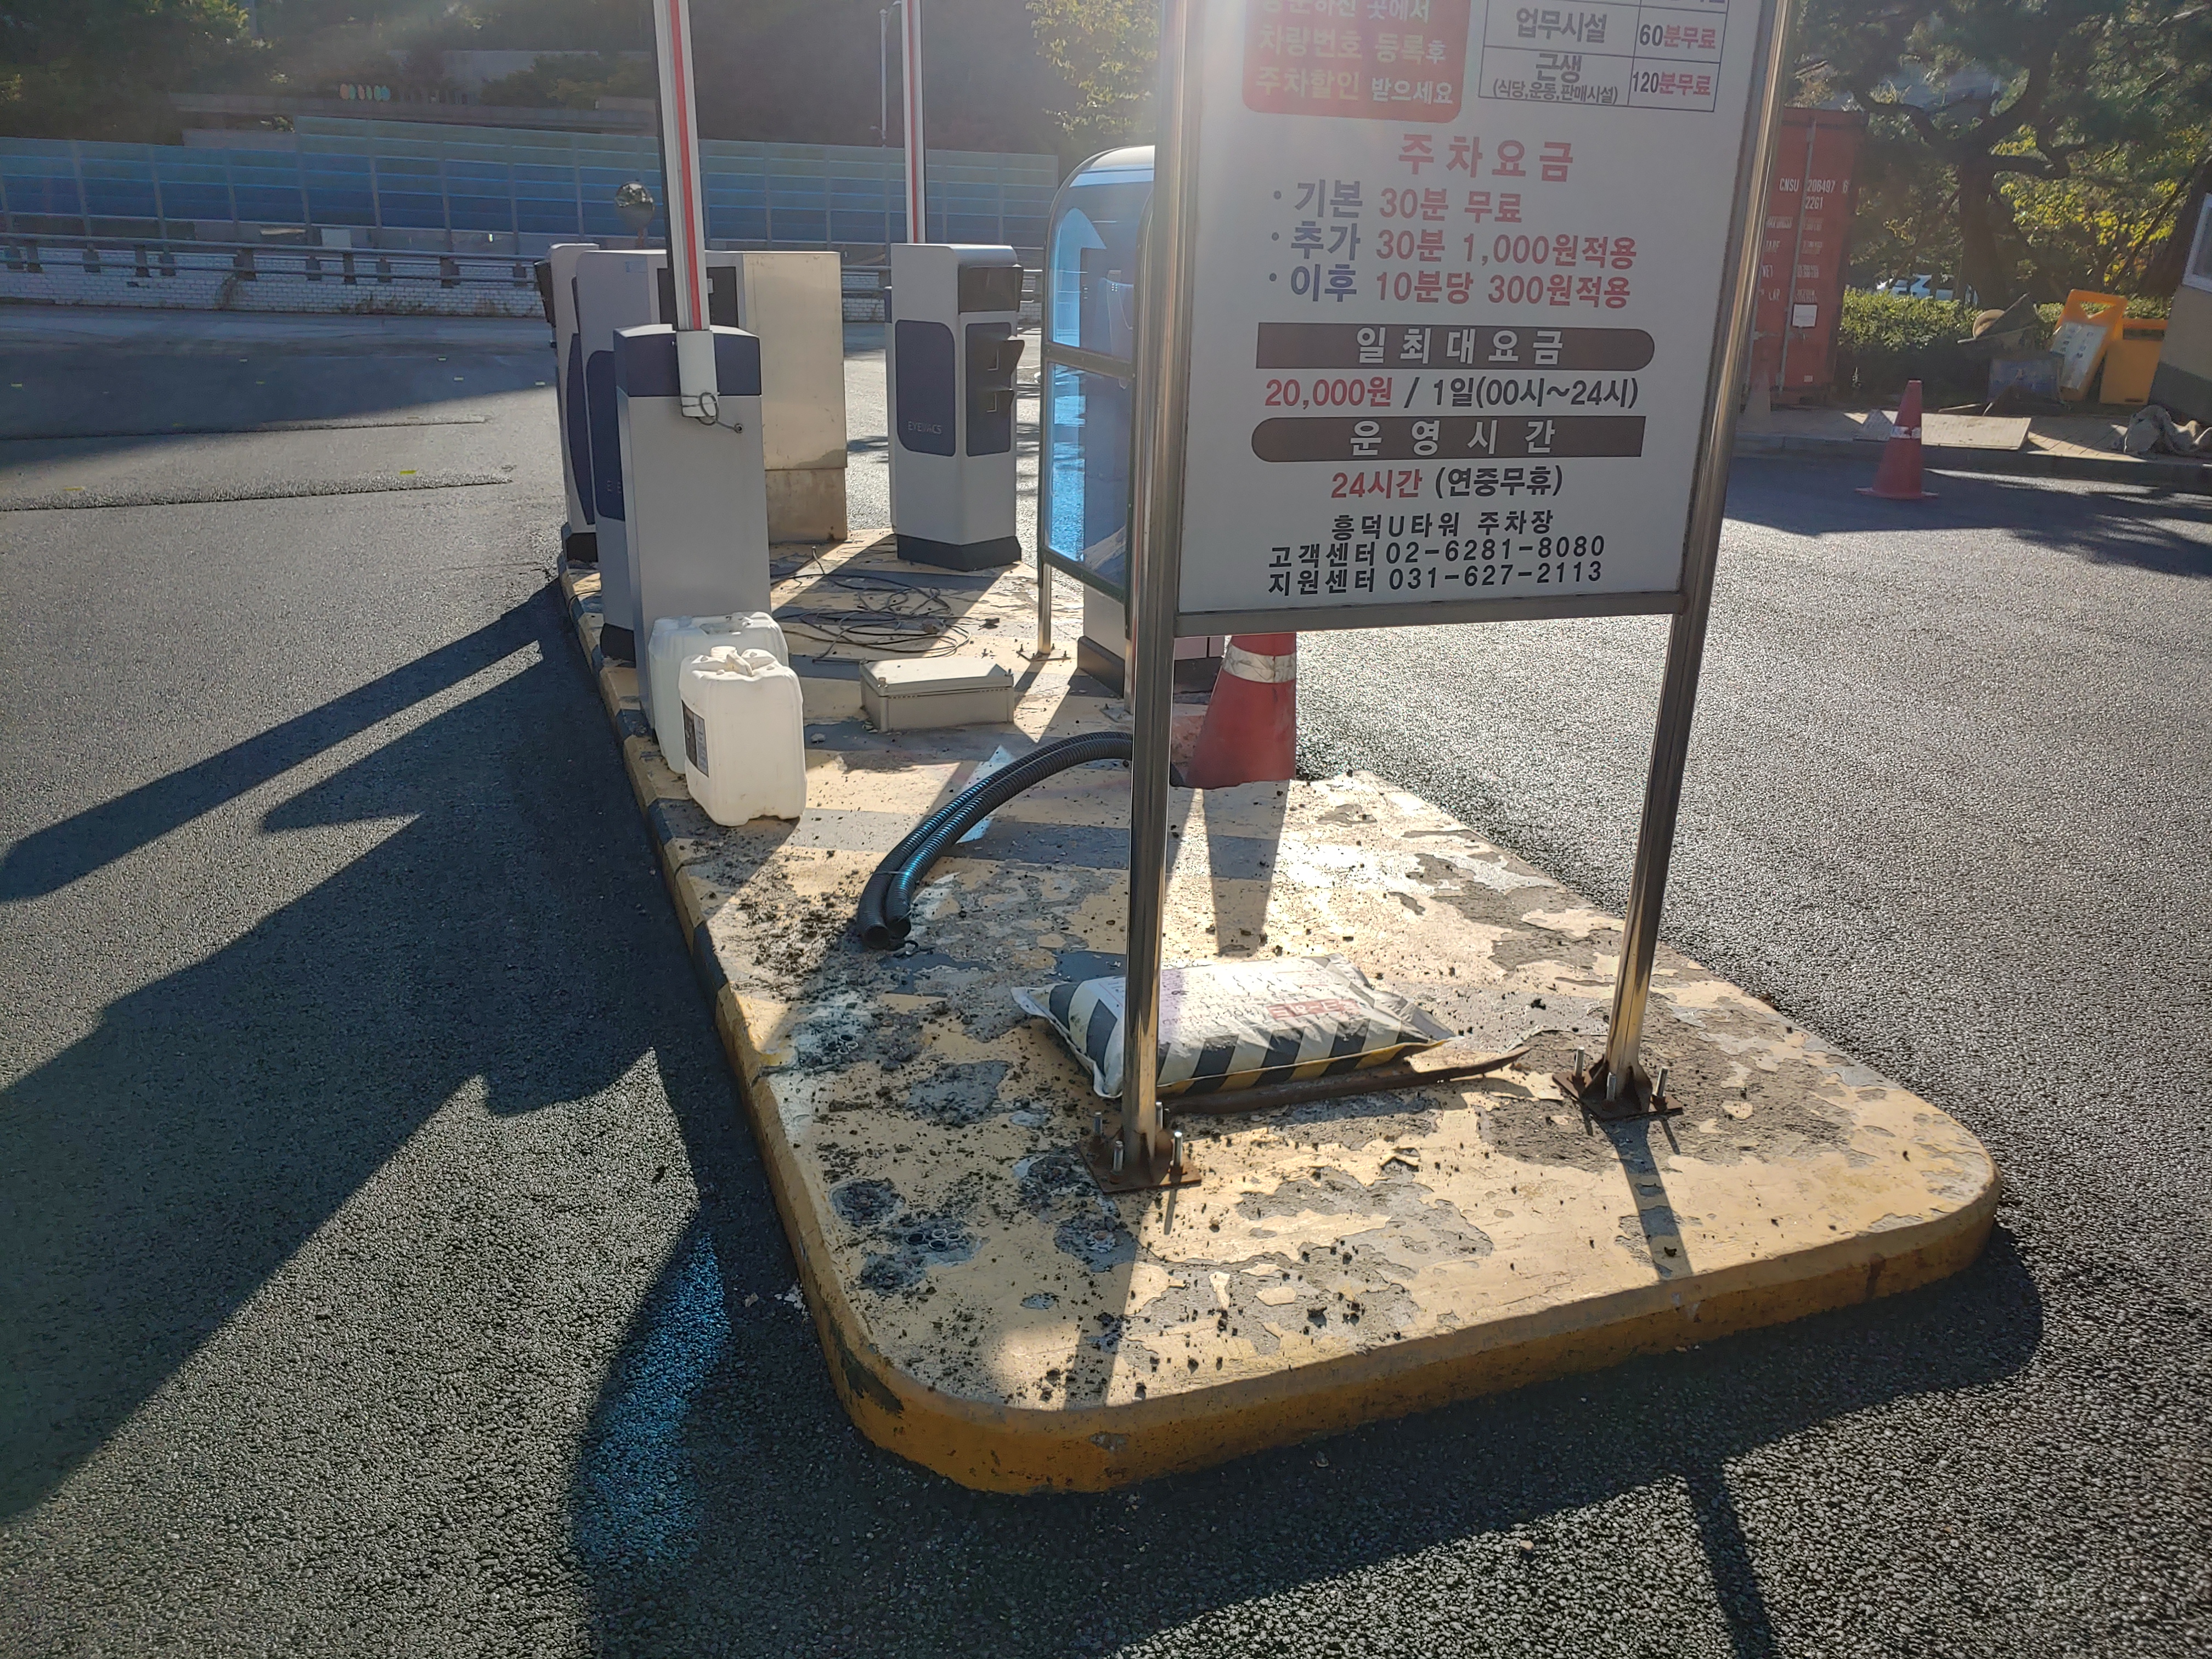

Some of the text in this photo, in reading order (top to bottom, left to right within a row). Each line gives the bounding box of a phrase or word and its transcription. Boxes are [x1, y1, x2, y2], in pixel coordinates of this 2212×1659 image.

[1516, 8, 1607, 44] 업무시설
[1639, 24, 1716, 50] 60분무료
[1260, 24, 1447, 65] 차량번호 등록후
[1255, 66, 1453, 105] 주차할인 받으세요
[1536, 53, 1582, 84] 근생
[1632, 71, 1711, 97] 120분무료
[1294, 178, 1522, 223] 기본 30분 무료
[1779, 178, 1799, 192] CNSU
[1807, 179, 1836, 193] 206497
[1290, 221, 1637, 270] 추가 30분 1,000원적용
[1290, 263, 1632, 309] 이후 10분당 300원적용
[1265, 376, 1393, 409] 20,000원
[1330, 465, 1564, 499] 24시간 (연중무휴)
[1331, 510, 1554, 541] 흥덕U타워 주차장
[1268, 535, 1605, 569] 고객센터 02-6281-8080
[1268, 560, 1602, 596] 지원센터 031-627-2113
